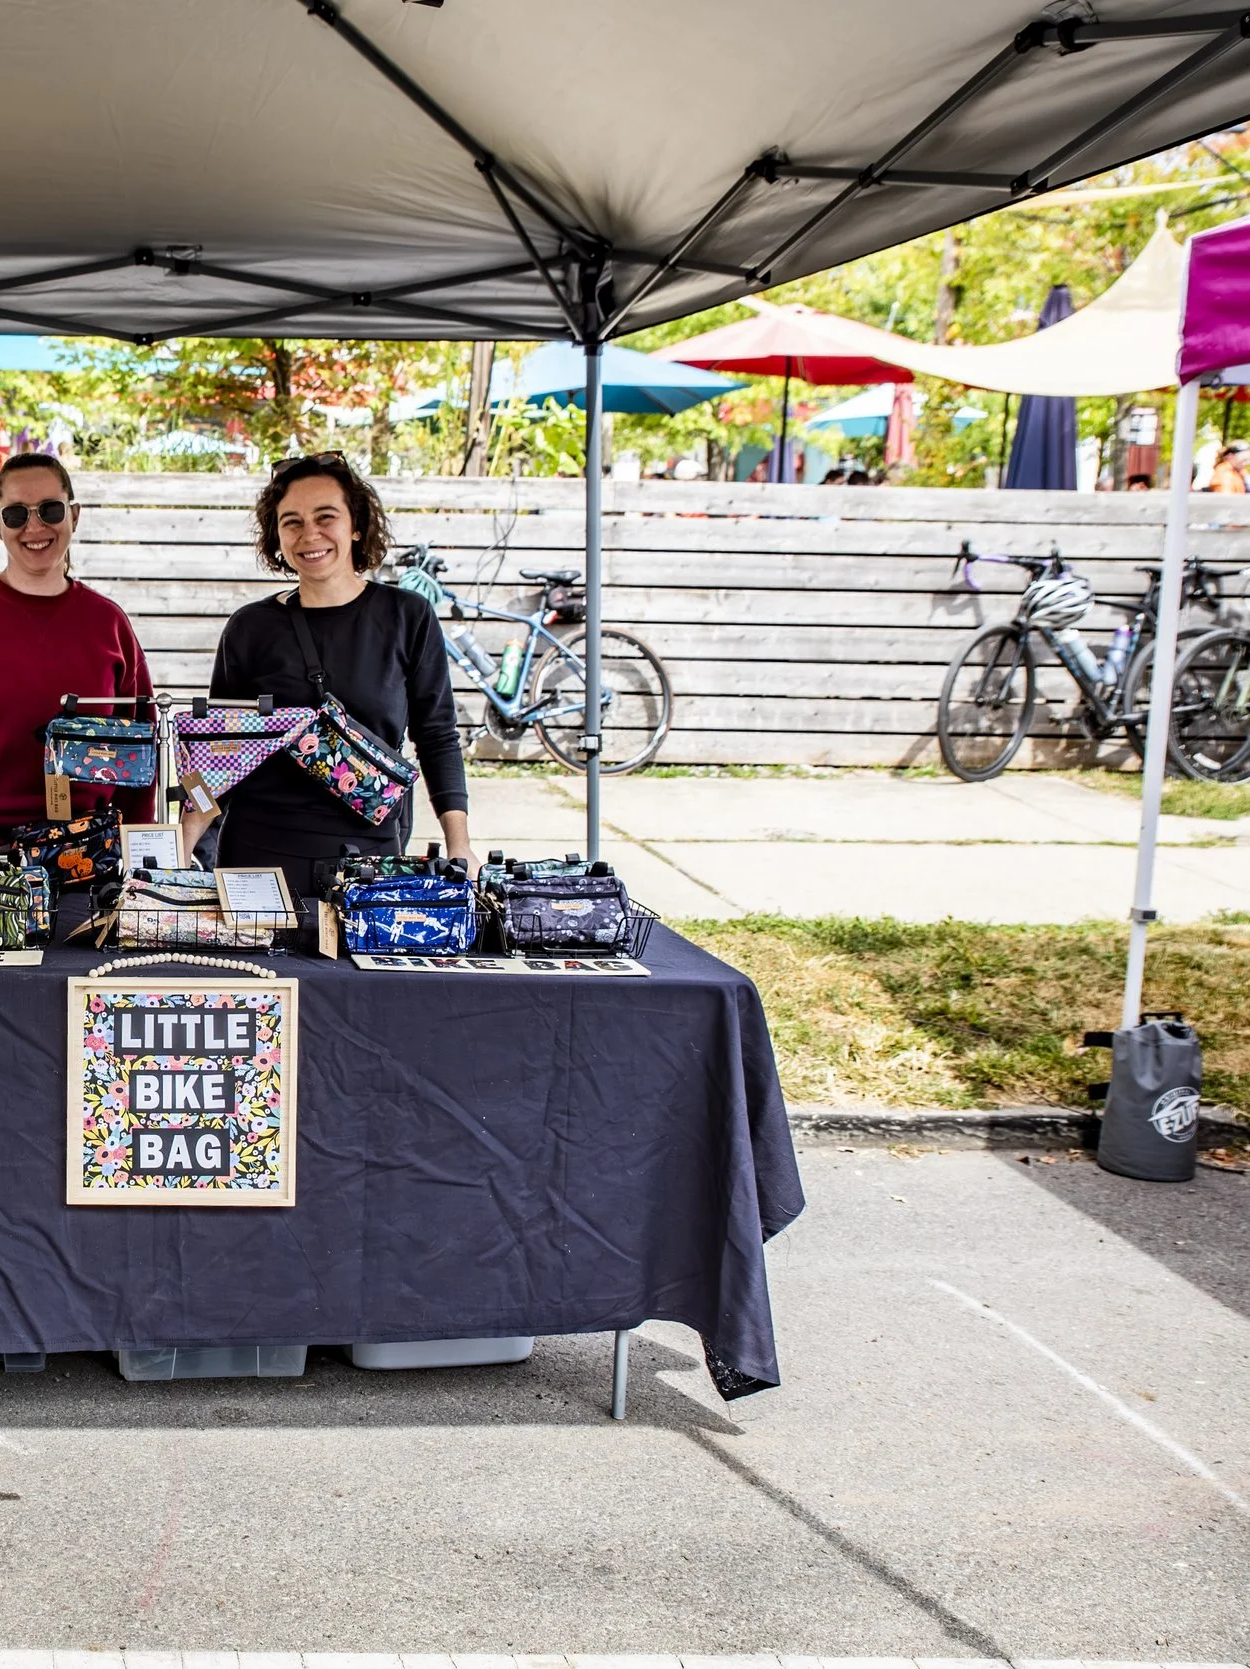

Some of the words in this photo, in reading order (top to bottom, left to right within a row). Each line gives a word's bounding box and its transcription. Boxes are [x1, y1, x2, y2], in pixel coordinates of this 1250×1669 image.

[370, 956, 505, 970] BIKE
[522, 959, 633, 971] BAG
[121, 1013, 250, 1049] LITTLE
[135, 1074, 226, 1110] BIKE
[139, 1133, 222, 1169] BAG
